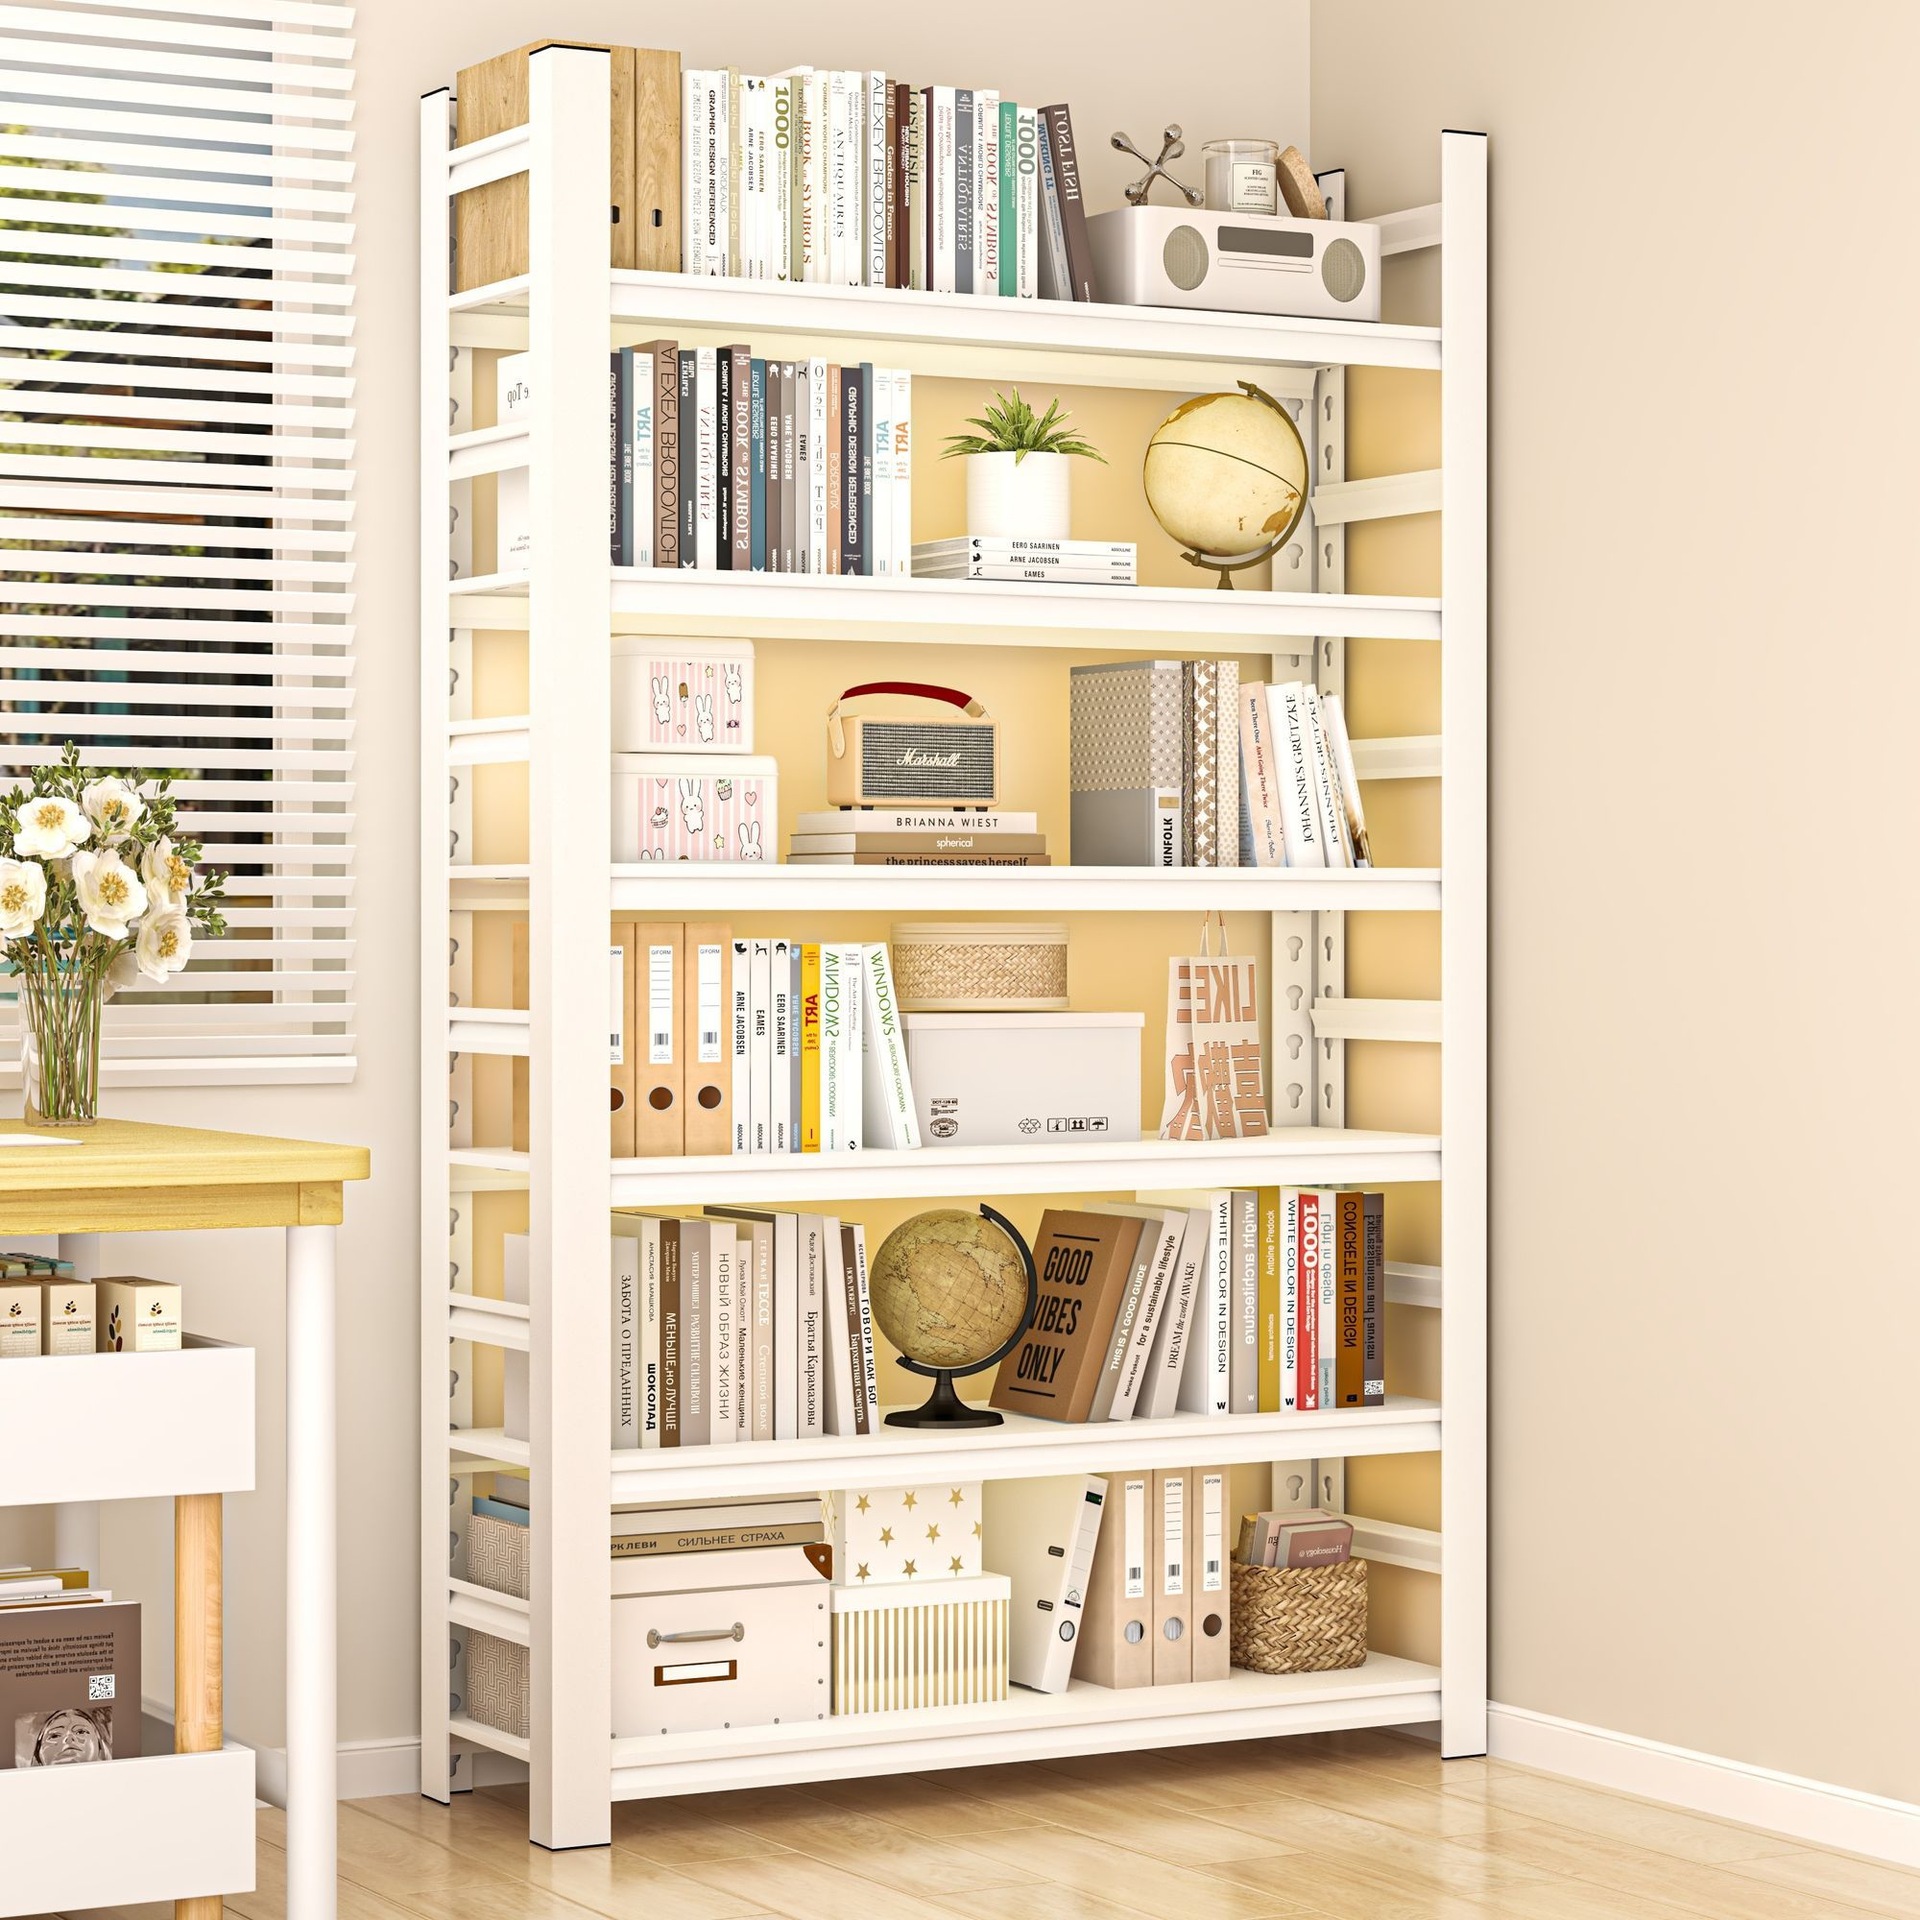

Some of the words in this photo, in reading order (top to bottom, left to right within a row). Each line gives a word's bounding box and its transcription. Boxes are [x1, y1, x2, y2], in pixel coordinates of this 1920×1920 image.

[775, 86, 790, 149] 1000
[873, 76, 884, 152] ALEXEY
[886, 146, 894, 190] Gardens
[887, 191, 894, 202] in
[873, 158, 884, 284] BRODOVITCH
[887, 205, 895, 240] France
[1012, 541, 1028, 549] EERO
[1030, 542, 1060, 550] SAARINEN
[1028, 556, 1060, 564] JACOBSEN
[1024, 570, 1045, 578] EAMES
[896, 748, 961, 768] Marshall
[896, 818, 955, 828] BRIANNA
[961, 818, 1000, 828] WIEST
[1295, 765, 1315, 843] JOHANNES
[886, 856, 906, 866] the
[907, 857, 956, 866] princess
[956, 858, 987, 866] saves
[988, 856, 1028, 866] herself
[936, 836, 974, 850] spherical
[1163, 817, 1173, 867] KINFOLK
[736, 991, 745, 1012] ARNE
[776, 994, 785, 1014] EERO
[870, 950, 896, 1036] WINDOWS
[736, 1014, 745, 1055] JACOBSEN
[756, 1010, 765, 1036] EAMES
[776, 1016, 785, 1055] SAARINEN
[1266, 1210, 1275, 1243] Predock
[1303, 1203, 1318, 1268] 1000
[718, 1254, 731, 1306] НОВЫЙ
[1044, 1246, 1094, 1286] GOOD
[1181, 1262, 1196, 1299] AWAKE
[1218, 1250, 1227, 1298] COLOR
[1266, 1245, 1274, 1276] Antoine
[1287, 1247, 1295, 1296] COLOR
[622, 1275, 632, 1324] ЗАБОТА
[1136, 1333, 1147, 1346] for
[1144, 1272, 1165, 1324] sustainable
[1158, 1235, 1176, 1270] lifestyle
[1179, 1298, 1188, 1318] world
[1219, 1303, 1226, 1316] IN
[1287, 1300, 1294, 1313] IN
[622, 1329, 632, 1339] О
[804, 1311, 818, 1352] Братья
[861, 1299, 873, 1354] ГОВОРИ
[1028, 1294, 1082, 1336] VIBES
[1110, 1348, 1123, 1371] THIS
[1118, 1338, 1126, 1347] IS
[1123, 1296, 1138, 1327] GOOD
[1132, 1264, 1148, 1295] GUIDE
[1175, 1319, 1185, 1330] the
[718, 1312, 730, 1360] ОБРАЗ
[738, 1328, 746, 1380] Маленькие
[1168, 1331, 1183, 1369] DREAM
[1218, 1321, 1226, 1373] DESIGN
[1286, 1317, 1295, 1369] DESIGN
[866, 1358, 874, 1380] КАК
[1017, 1343, 1065, 1384] ONLY
[620, 1343, 632, 1426] ПРЕДАННЫХ
[646, 1364, 656, 1430] ШОКОЛАД
[718, 1364, 730, 1420] ЖИЗНИ
[804, 1355, 818, 1426] Карамазовы
[868, 1385, 877, 1406] БОГ
[1124, 1376, 1134, 1397] Marieke
[666, 1387, 676, 1430] ЛУЧШЕ
[626, 1541, 657, 1550] ЛЕВИ
[677, 1535, 736, 1547] СИЛЬНЕЕ
[740, 1531, 785, 1542] СТРАХА
